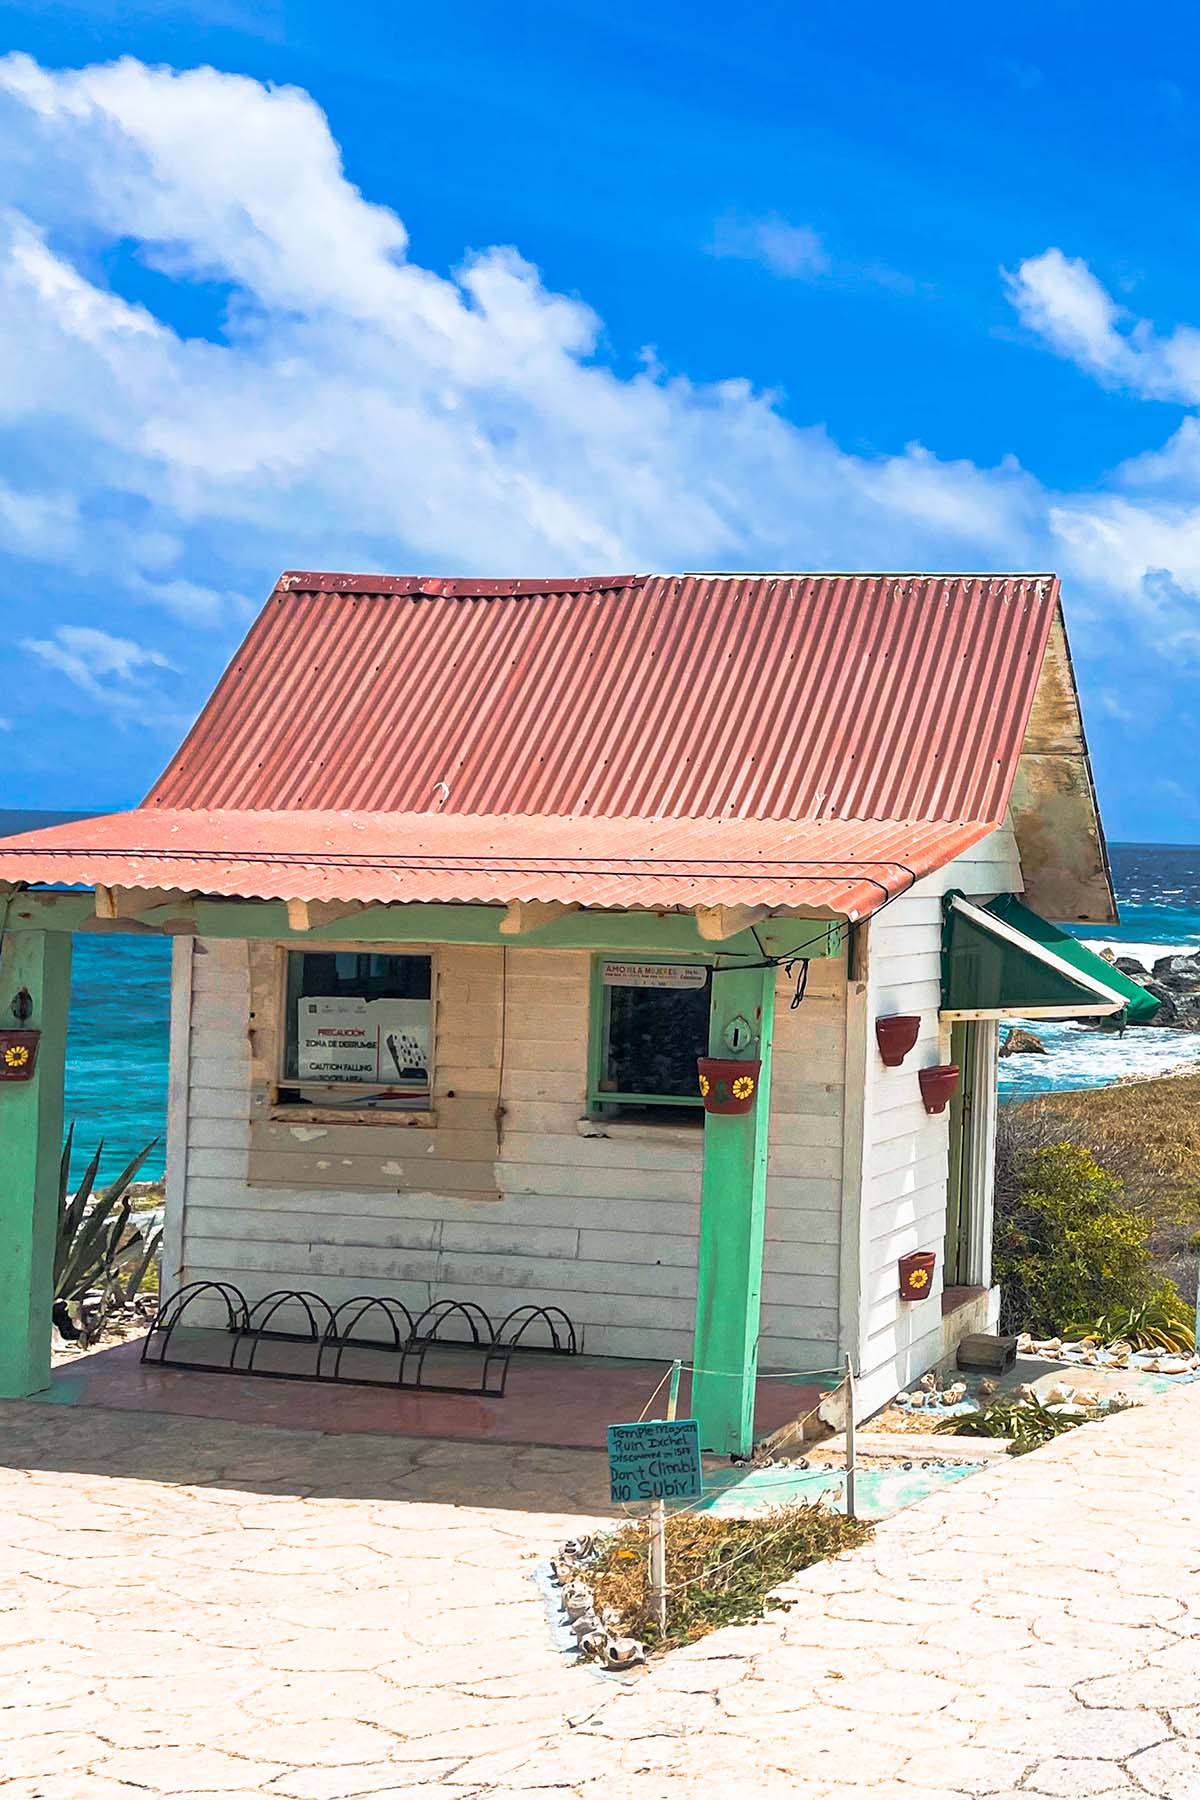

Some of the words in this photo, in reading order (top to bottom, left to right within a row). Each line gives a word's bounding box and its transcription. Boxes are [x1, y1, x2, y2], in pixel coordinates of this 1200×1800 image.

[606, 965, 625, 973] AMO
[318, 1027, 365, 1037] PRECAUCIÓN
[305, 1040, 327, 1048] ZONA
[328, 1040, 338, 1048] DE
[309, 1062, 342, 1071] CAUTION
[344, 1063, 373, 1072] FALLING
[609, 1425, 654, 1439] Temple
[655, 1423, 697, 1436] Mayan
[612, 1440, 645, 1452] Ruin
[648, 1434, 687, 1448] Ixchel
[649, 1457, 697, 1477] Climb!
[611, 1484, 631, 1501] NO
